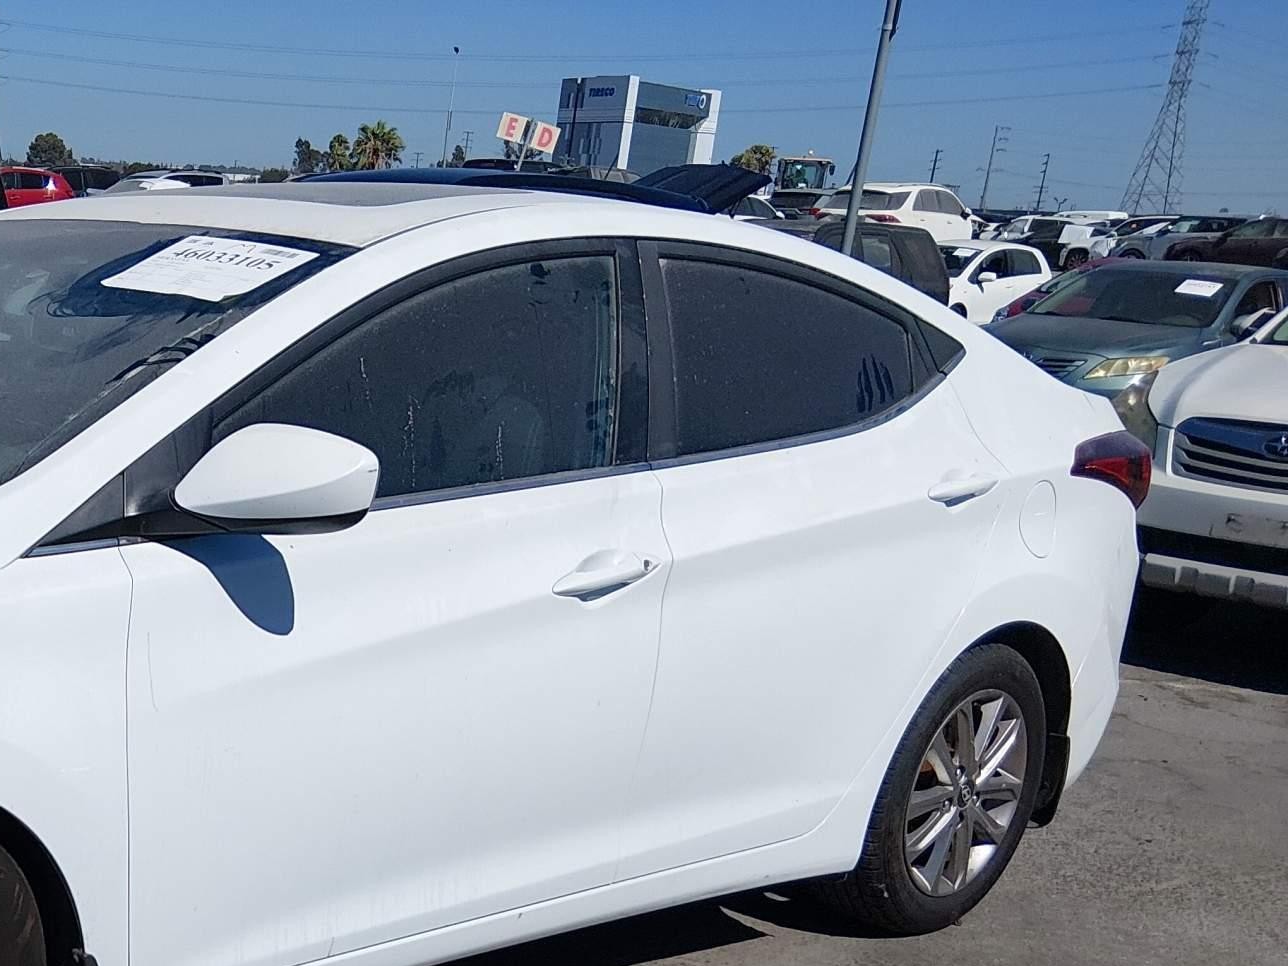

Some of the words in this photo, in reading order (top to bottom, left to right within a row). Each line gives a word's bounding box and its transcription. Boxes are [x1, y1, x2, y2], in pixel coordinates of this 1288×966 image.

[505, 117, 518, 137] E
[537, 127, 552, 147] D
[173, 246, 280, 270] 46033105
